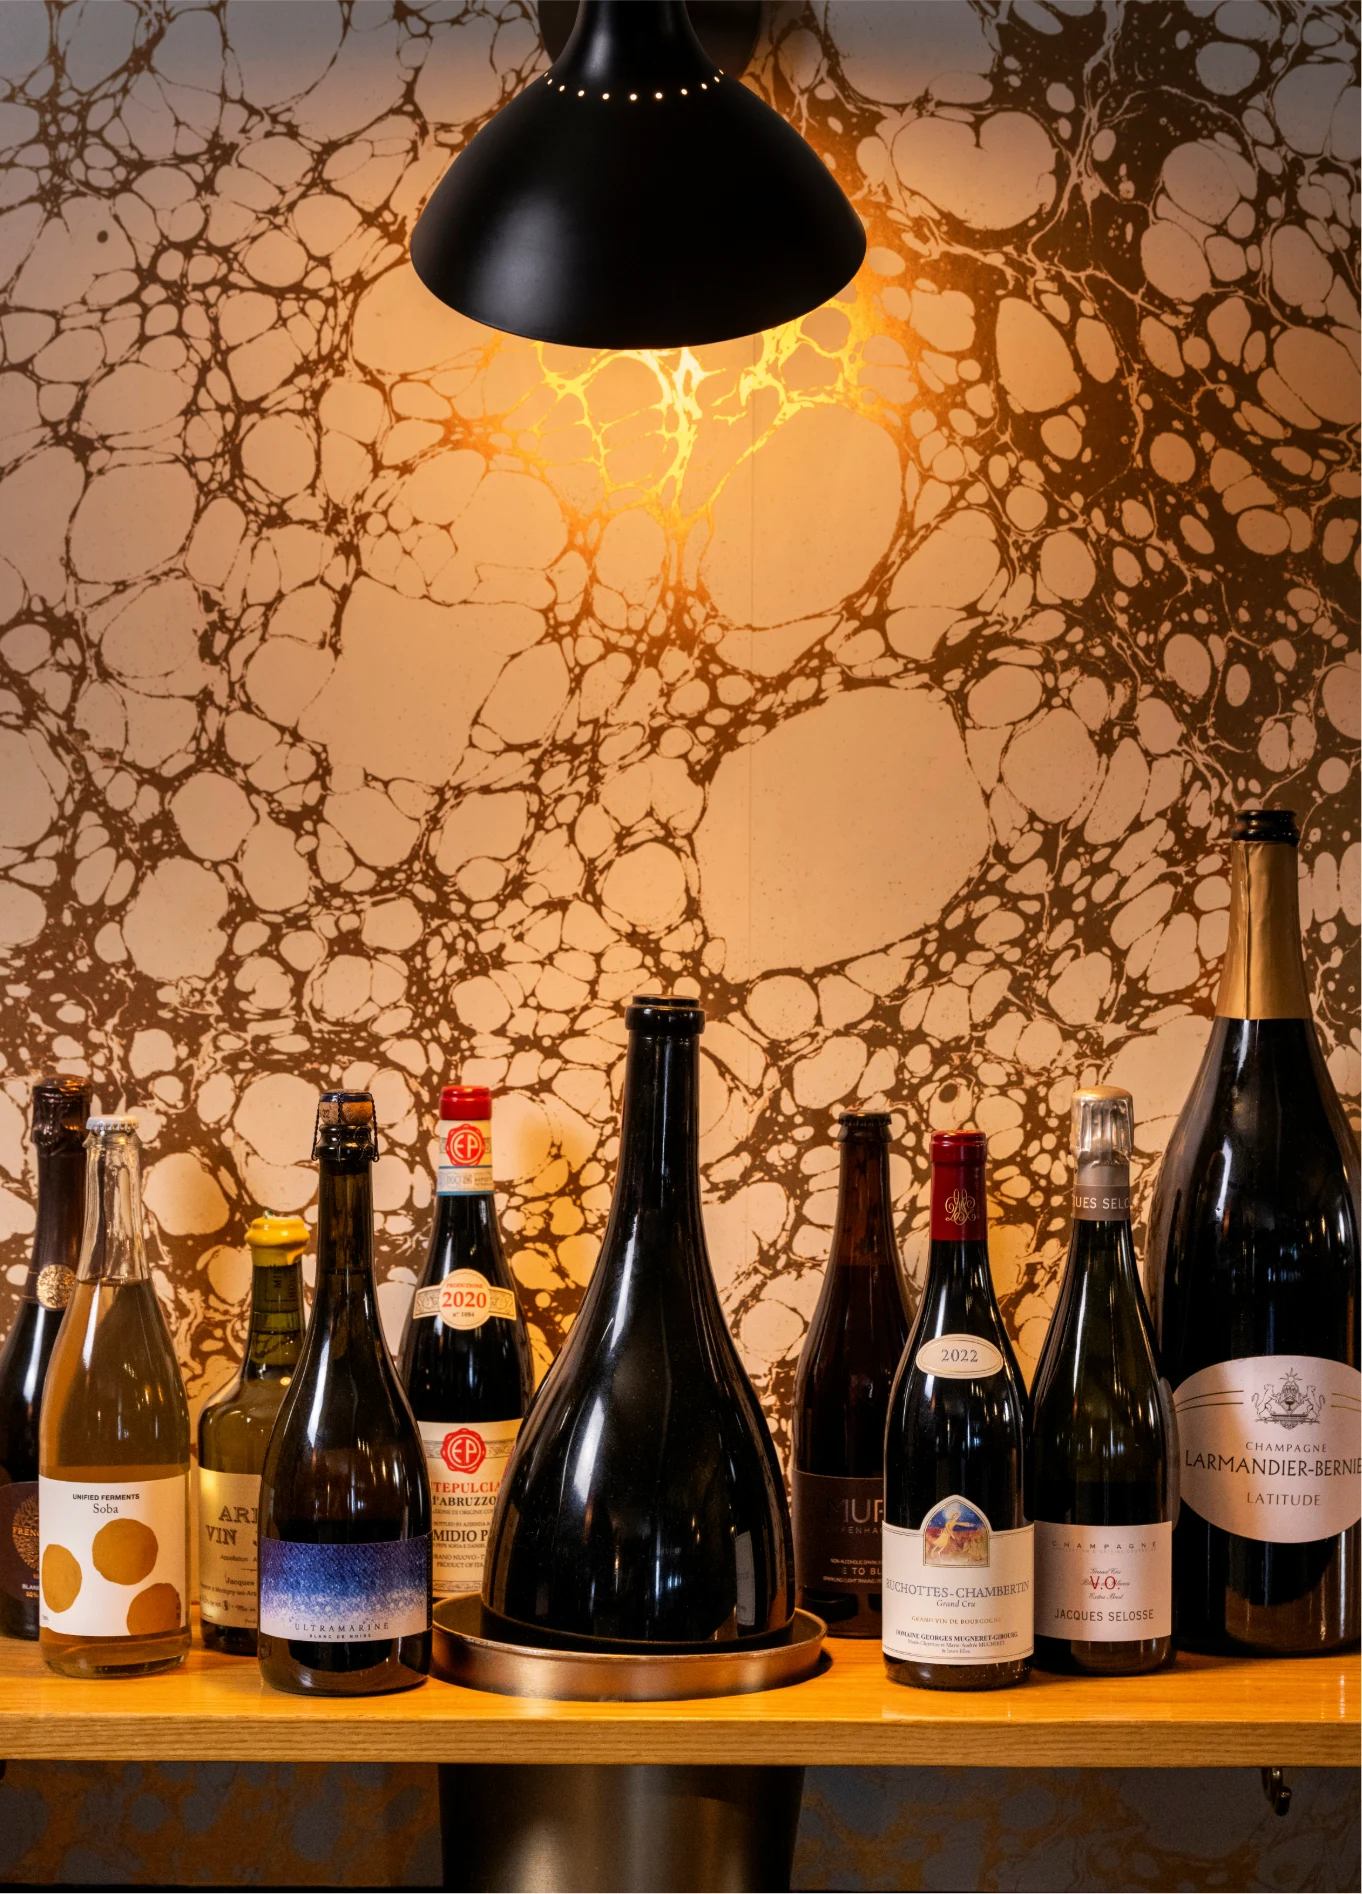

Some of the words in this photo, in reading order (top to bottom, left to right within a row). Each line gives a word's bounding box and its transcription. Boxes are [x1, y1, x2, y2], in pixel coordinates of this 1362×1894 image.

[442, 1291, 487, 1309] 2020
[941, 1348, 978, 1363] 2022
[1245, 1441, 1328, 1453] CHAMPAGNE
[1185, 1449, 1361, 1478] LARMANDIER-BERNIE
[72, 1493, 100, 1501] UNIFIED
[101, 1493, 140, 1501] FERMENTS
[1247, 1492, 1322, 1507] LATITUDE
[92, 1503, 119, 1514] Soba
[205, 1524, 237, 1546] VIN
[1052, 1541, 1157, 1550] CHAMPAGNE
[851, 1567, 866, 1576] TO
[226, 1577, 255, 1587] Jacques
[1089, 1575, 1121, 1590] V.O.
[1088, 1592, 1106, 1600] Extra
[936, 1599, 960, 1608] Grand
[961, 1600, 976, 1608] Cru
[911, 1615, 934, 1623] GRAND
[935, 1617, 948, 1625] VIN
[960, 1616, 1002, 1625] BOURGOGNE
[1054, 1608, 1104, 1621] JACQUES
[1108, 1608, 1155, 1622] SELOSSE
[294, 1621, 390, 1634] ULTRAMARINE
[895, 1629, 921, 1640] DOMAINE
[920, 1633, 953, 1642] GEORGES
[953, 1631, 1019, 1643] MUGNERET-GIBOURG
